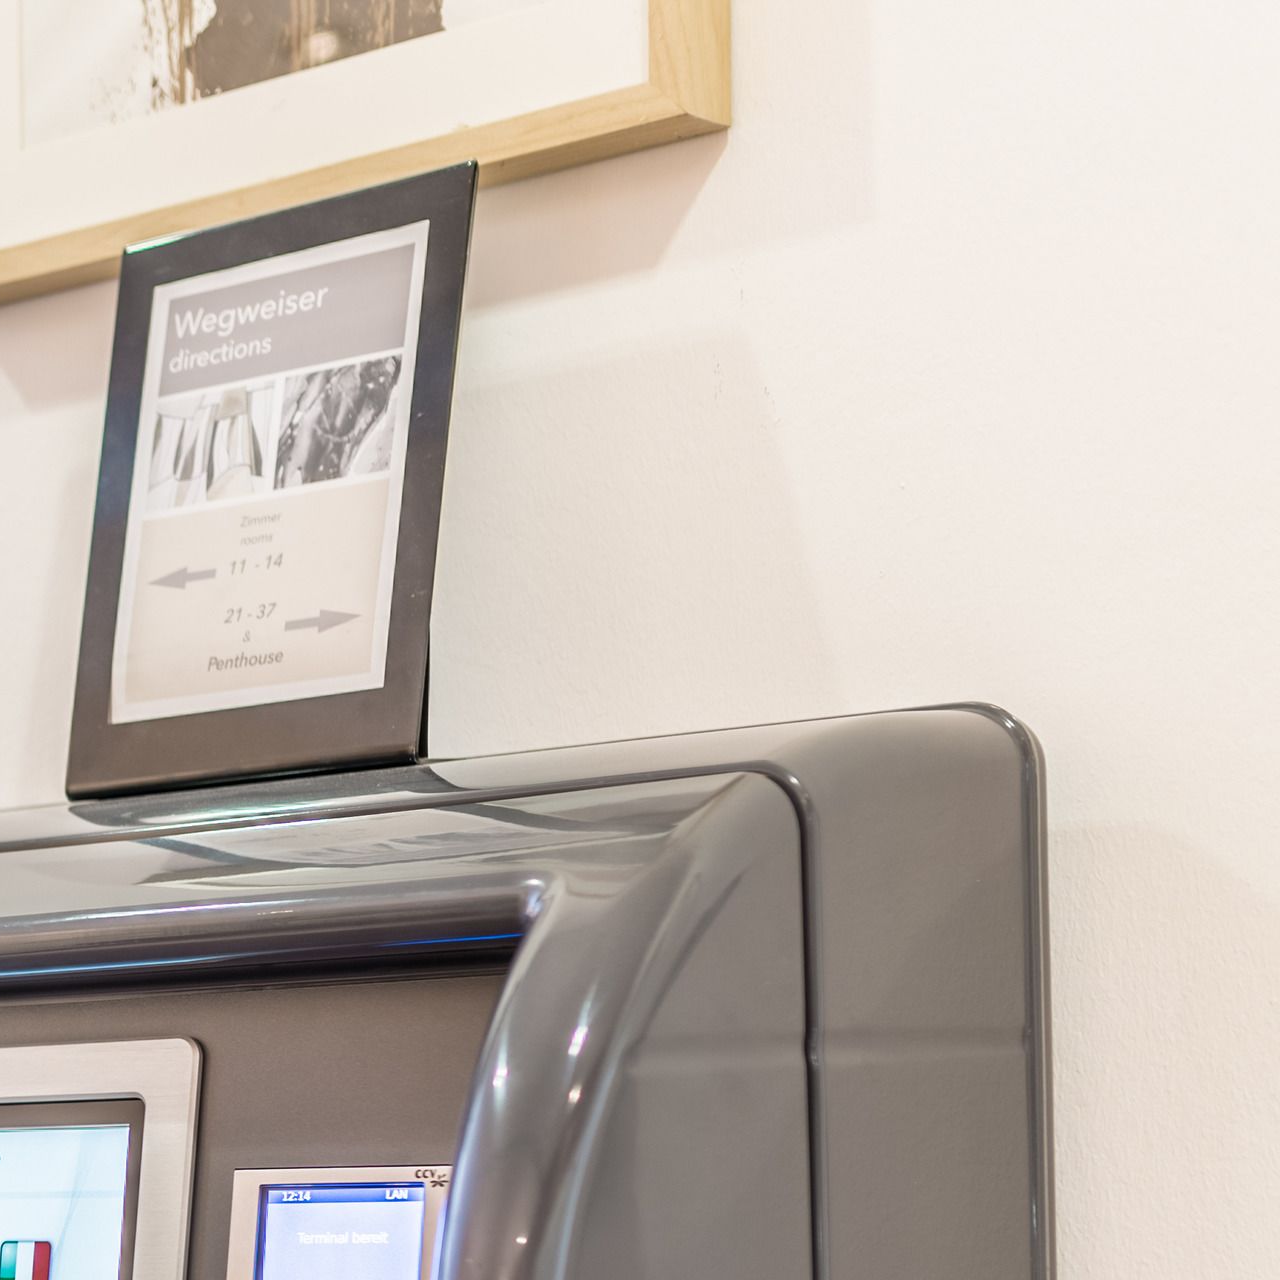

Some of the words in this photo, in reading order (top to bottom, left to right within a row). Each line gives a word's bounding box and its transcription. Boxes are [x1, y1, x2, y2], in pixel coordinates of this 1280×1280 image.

[175, 287, 328, 338] Wegweiser
[169, 337, 272, 373] directions
[240, 513, 281, 528] Zimmer
[240, 533, 273, 546] rooms
[229, 558, 247, 575] 11
[265, 553, 283, 569] 14
[224, 607, 242, 624] 21
[256, 602, 277, 620] 37
[207, 651, 284, 672] Penthouse
[282, 1190, 311, 1201] 12:14
[385, 1189, 408, 1200] LAN
[296, 1232, 349, 1244] Terminal
[352, 1231, 389, 1244] bereit
